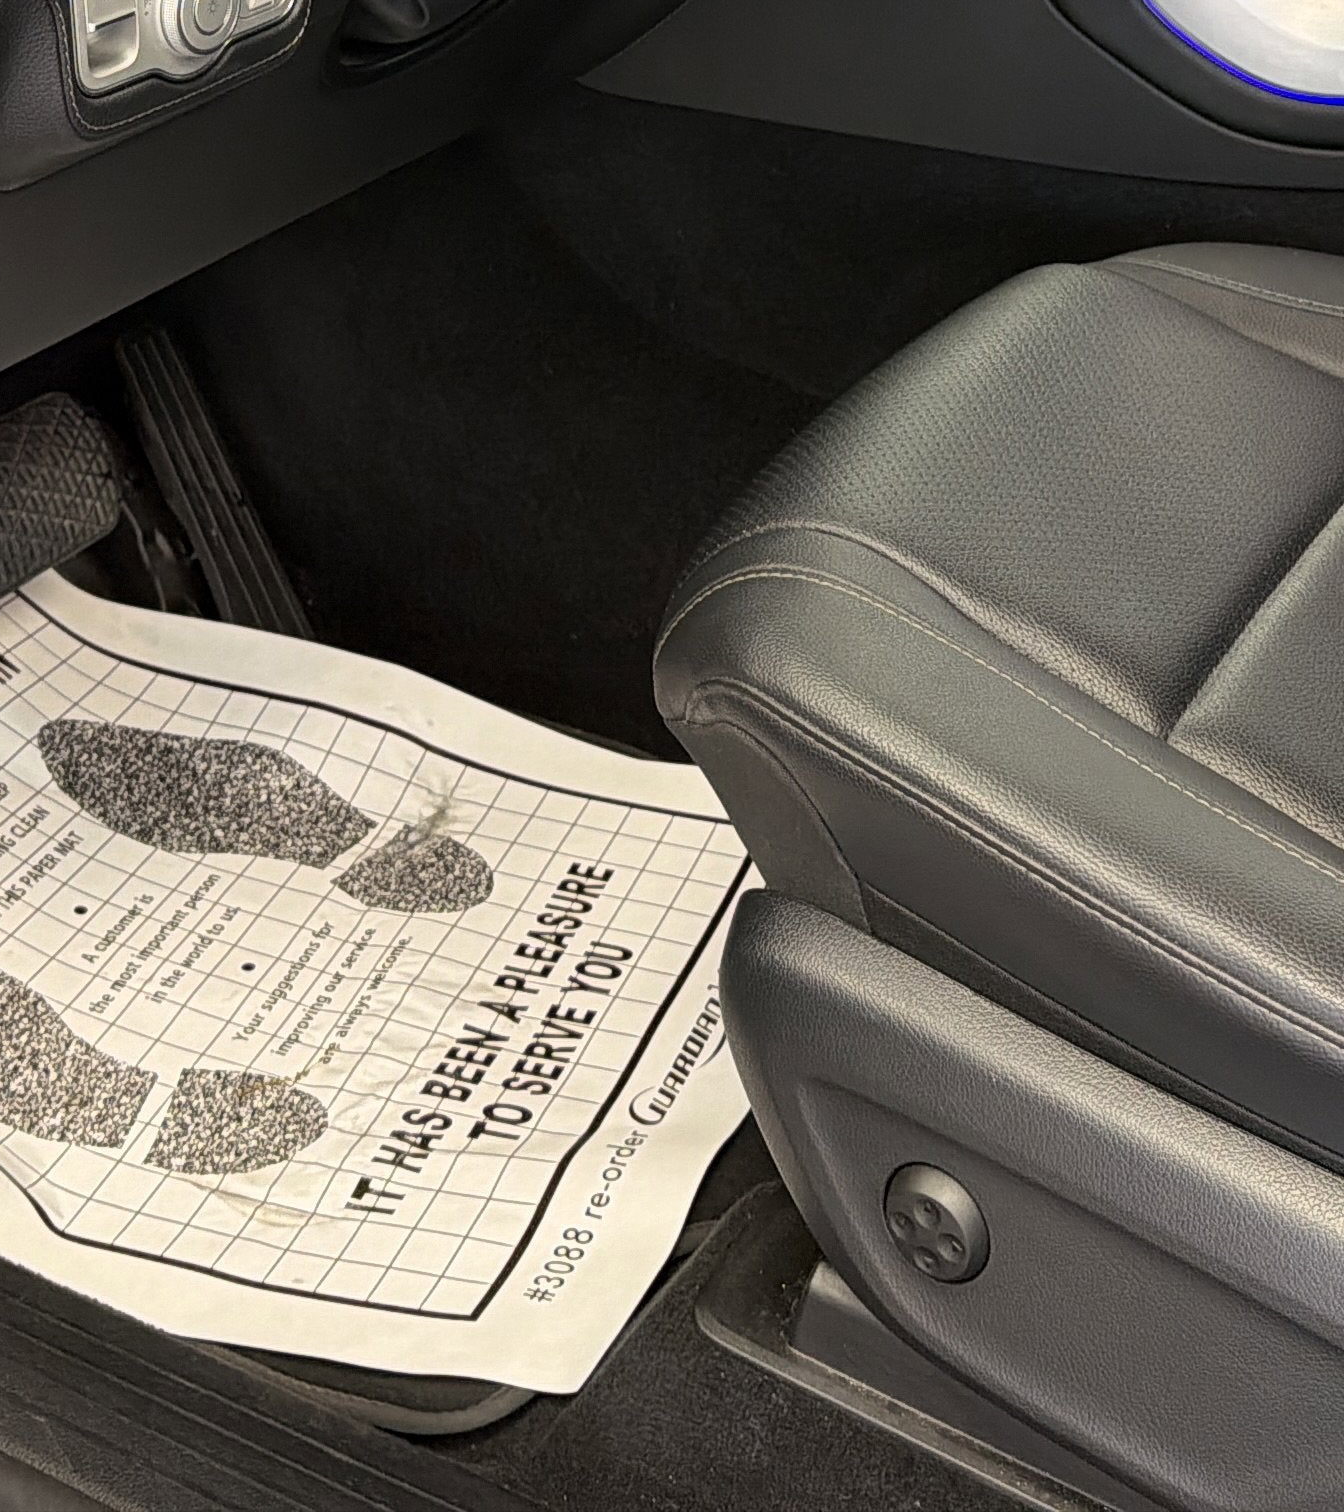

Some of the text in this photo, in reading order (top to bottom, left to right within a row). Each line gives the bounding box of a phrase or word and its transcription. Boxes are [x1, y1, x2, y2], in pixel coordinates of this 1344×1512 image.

[10, 805, 50, 838] CLEAN
[20, 854, 61, 888] PAPER
[54, 831, 84, 856] MAT
[81, 894, 154, 964] A customer is
[89, 873, 221, 1014] the most important person
[145, 990, 168, 1004] in
[160, 969, 186, 989] the
[181, 934, 213, 968] world
[206, 924, 225, 936] to
[232, 921, 335, 1041] Your suggestions for
[270, 928, 377, 1057] improving our service
[319, 1042, 340, 1065] are
[336, 994, 372, 1038] always
[344, 862, 615, 1216] IT HAS BEEN A PLEASURE
[467, 941, 633, 1140] TO SERVE YOU
[523, 1226, 594, 1303] #3088
[585, 1129, 649, 1219] re-order
